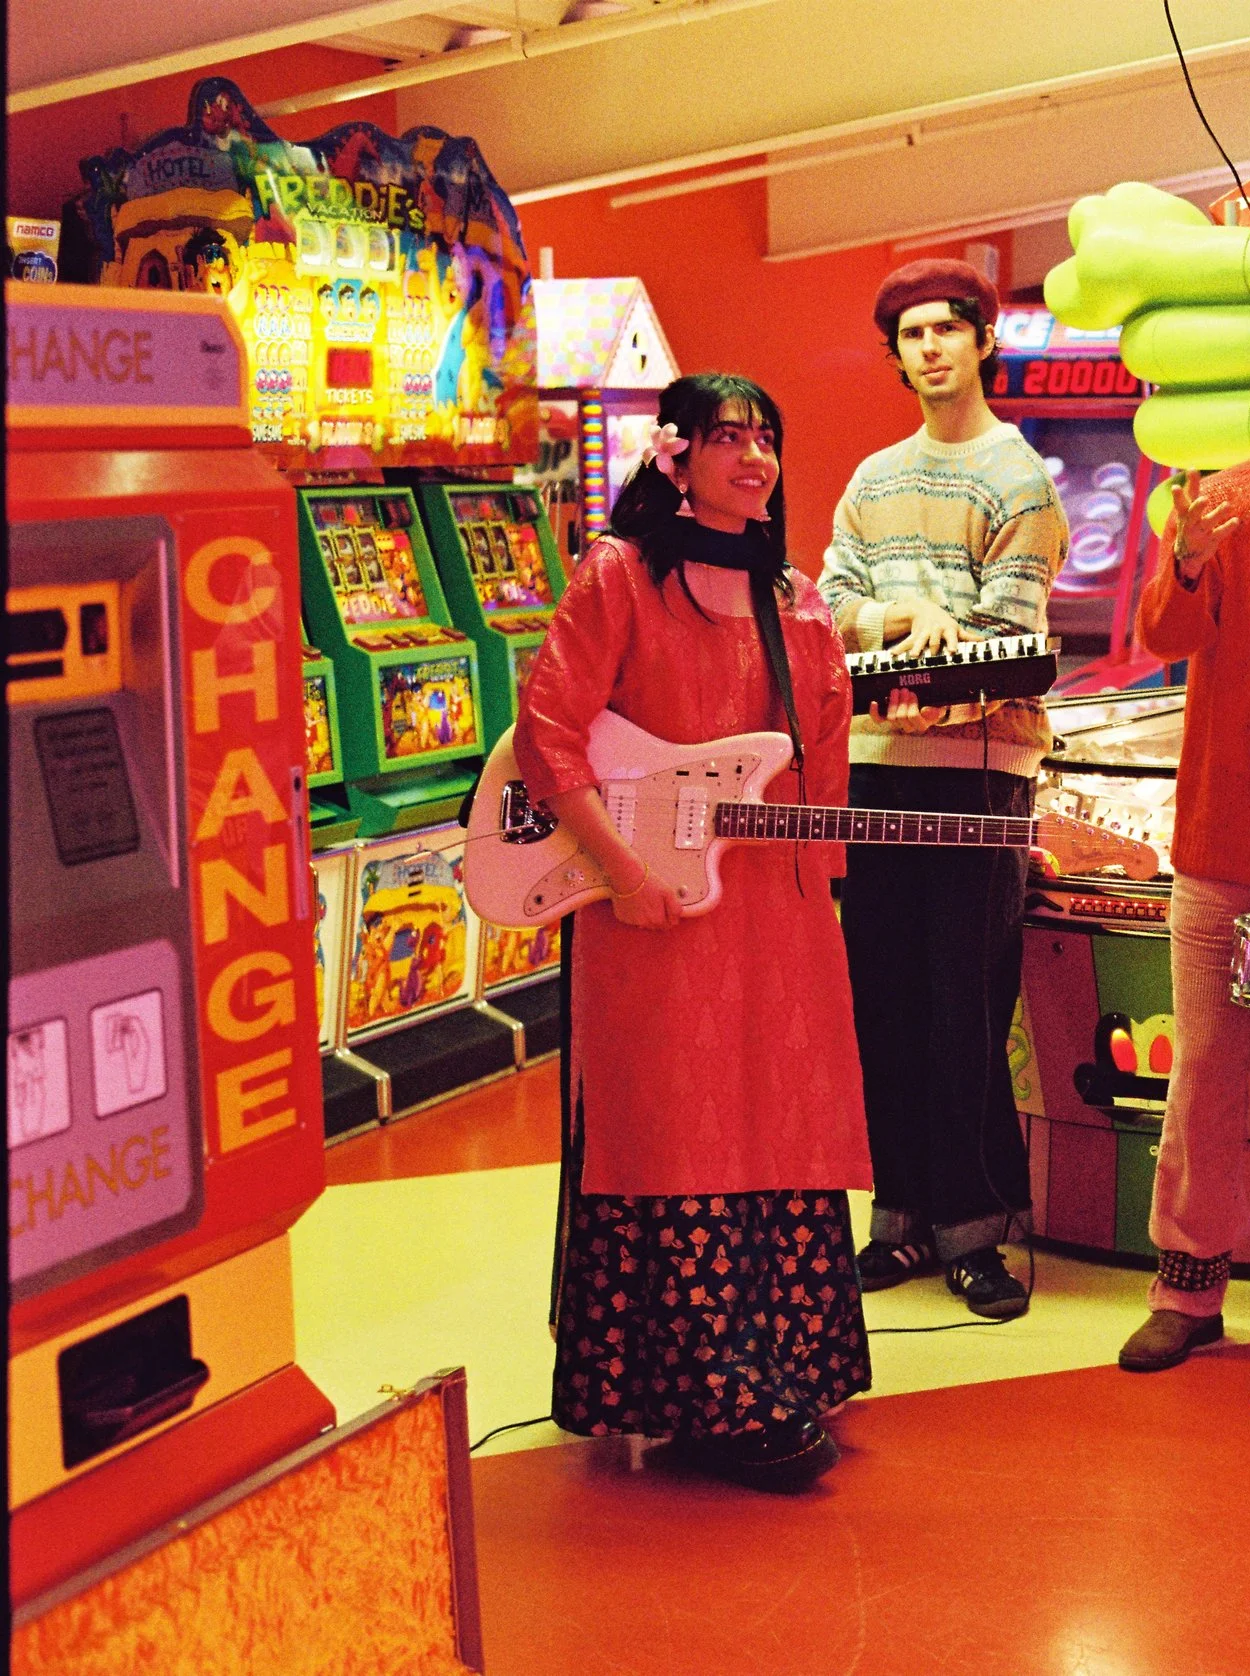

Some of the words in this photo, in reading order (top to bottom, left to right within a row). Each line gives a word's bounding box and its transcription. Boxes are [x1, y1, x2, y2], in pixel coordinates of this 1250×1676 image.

[147, 156, 210, 181] HOTEL
[16, 223, 54, 238] namco
[9, 327, 155, 384] HANGE
[899, 672, 931, 687] KORG
[184, 536, 299, 1156] CHANGE
